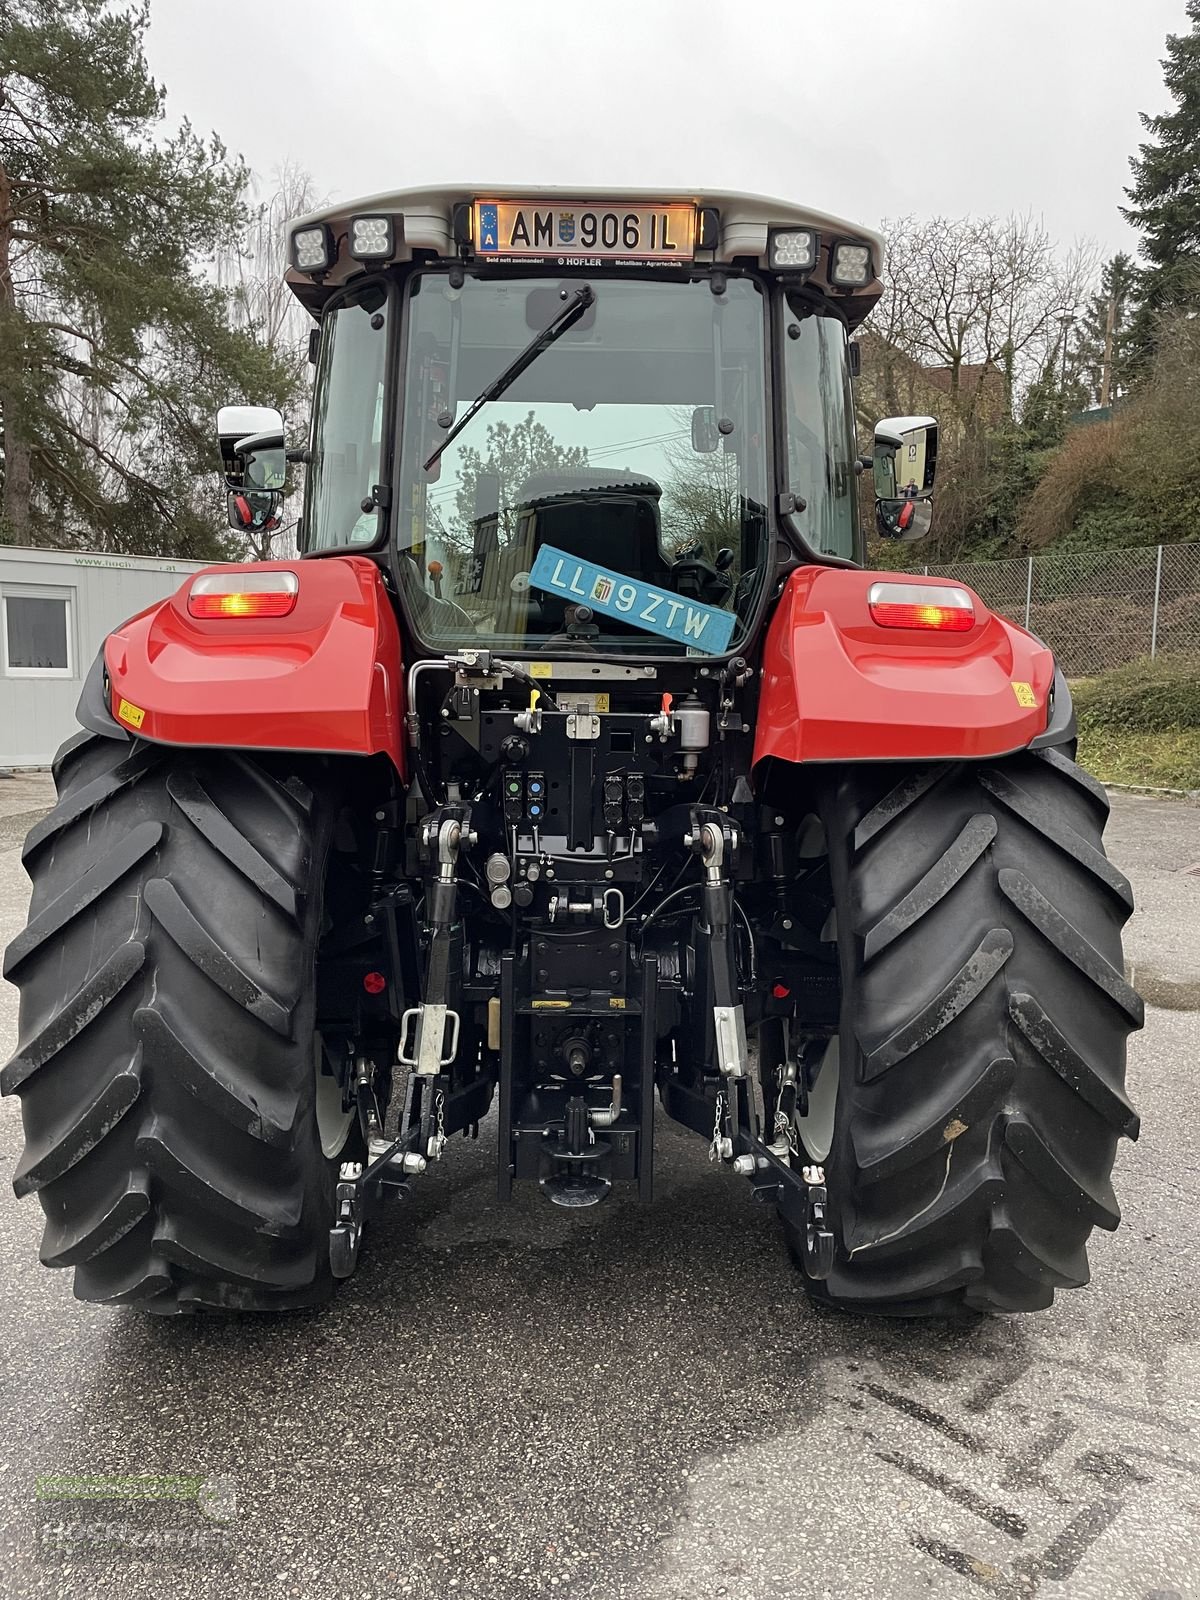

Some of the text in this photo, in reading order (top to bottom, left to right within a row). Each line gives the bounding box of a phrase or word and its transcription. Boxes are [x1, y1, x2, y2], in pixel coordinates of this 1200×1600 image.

[484, 233, 494, 245] A
[509, 211, 677, 250] AM 906 IL
[550, 558, 710, 639] LL 9 ZTW
